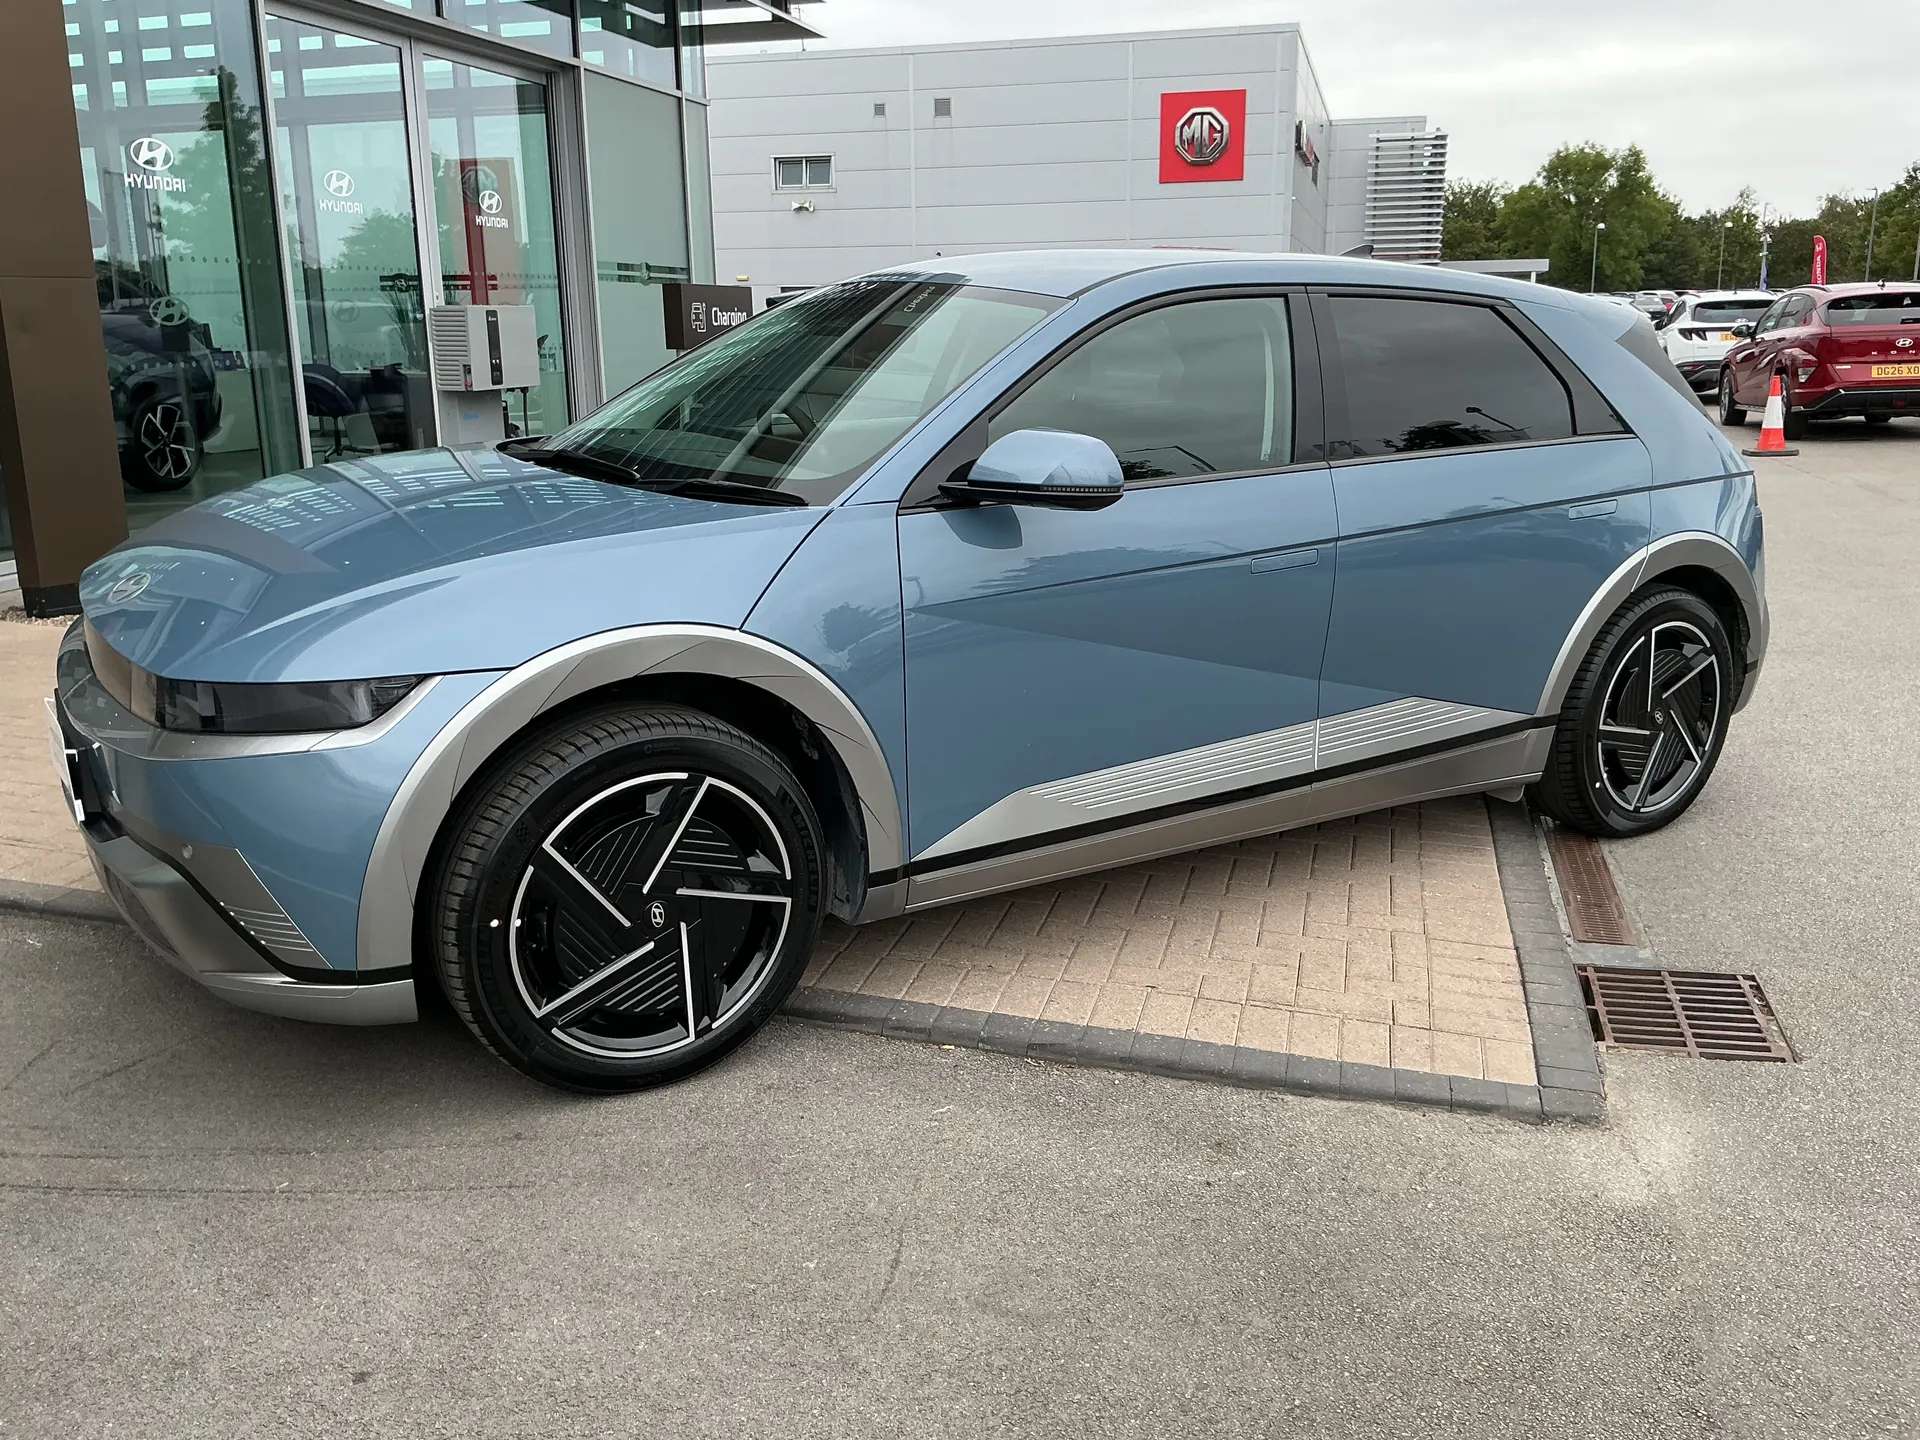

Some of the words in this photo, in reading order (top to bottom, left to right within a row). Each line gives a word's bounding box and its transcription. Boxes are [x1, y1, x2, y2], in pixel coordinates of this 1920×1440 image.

[1181, 113, 1225, 158] MG
[124, 173, 187, 192] HYUNDAI
[320, 199, 364, 214] HYUNDAI
[475, 215, 509, 229] HYUNDAI
[1876, 366, 1904, 376] DG26
